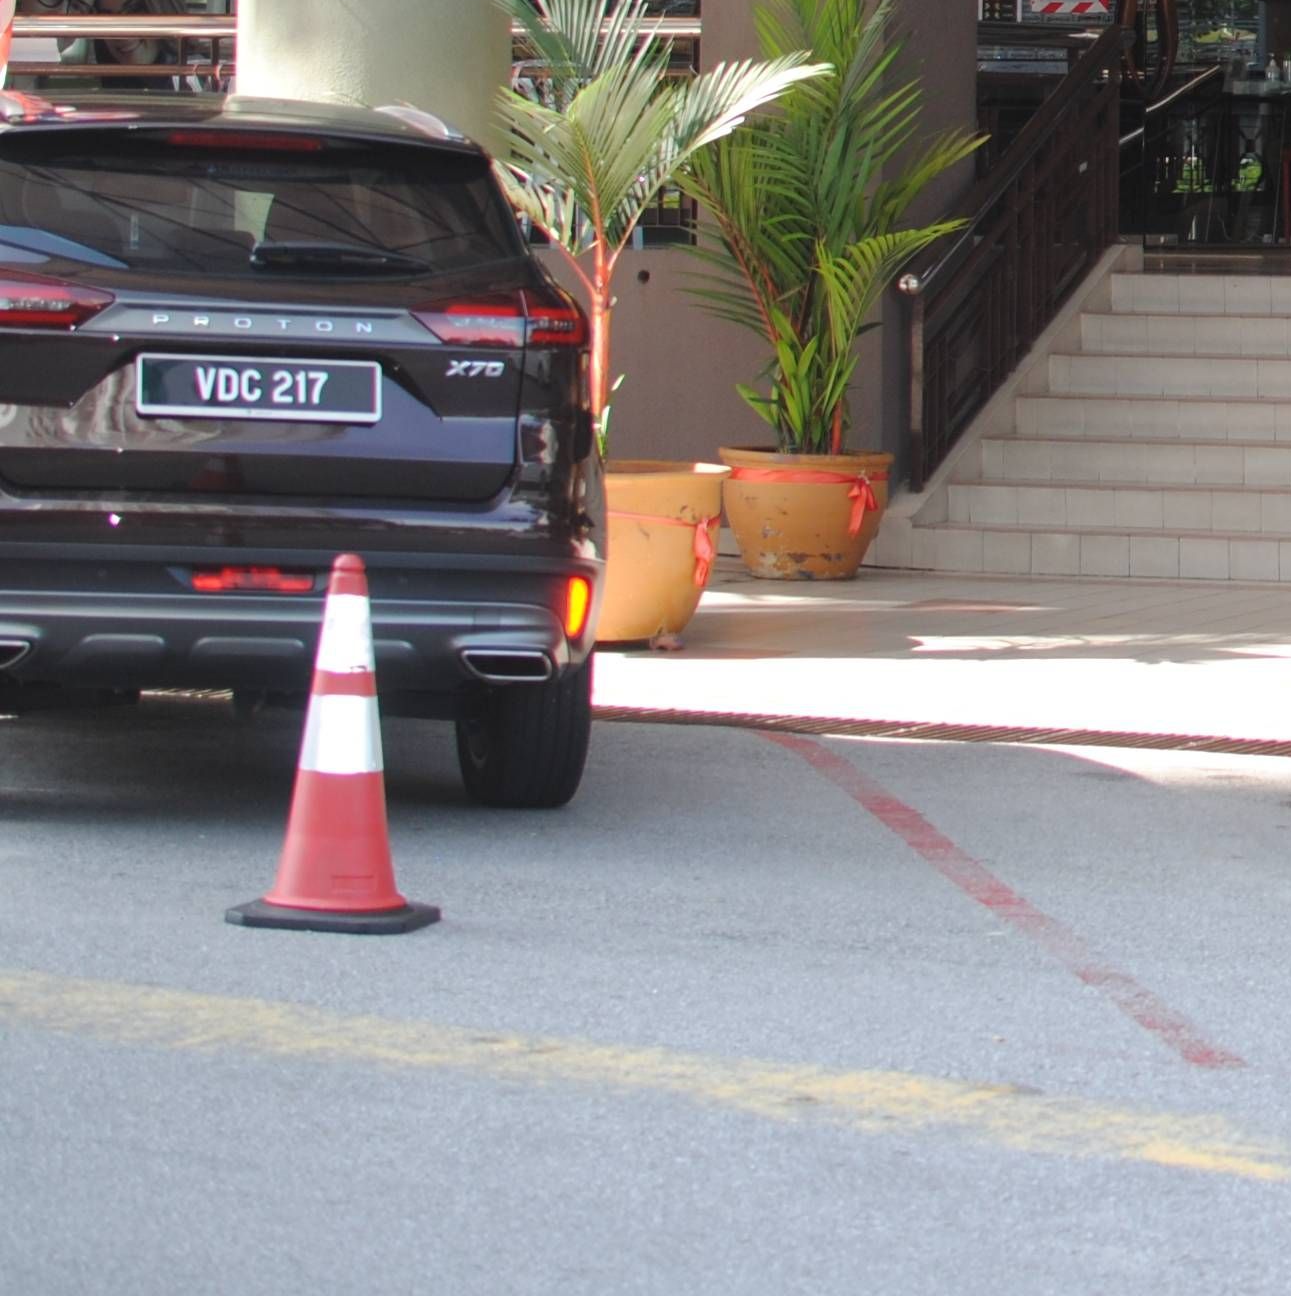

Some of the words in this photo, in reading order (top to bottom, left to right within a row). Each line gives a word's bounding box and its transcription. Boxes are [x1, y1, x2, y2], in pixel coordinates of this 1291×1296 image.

[152, 314, 373, 333] PROTON
[445, 359, 505, 378] X70
[194, 366, 262, 403] VDC
[272, 370, 329, 405] 217
